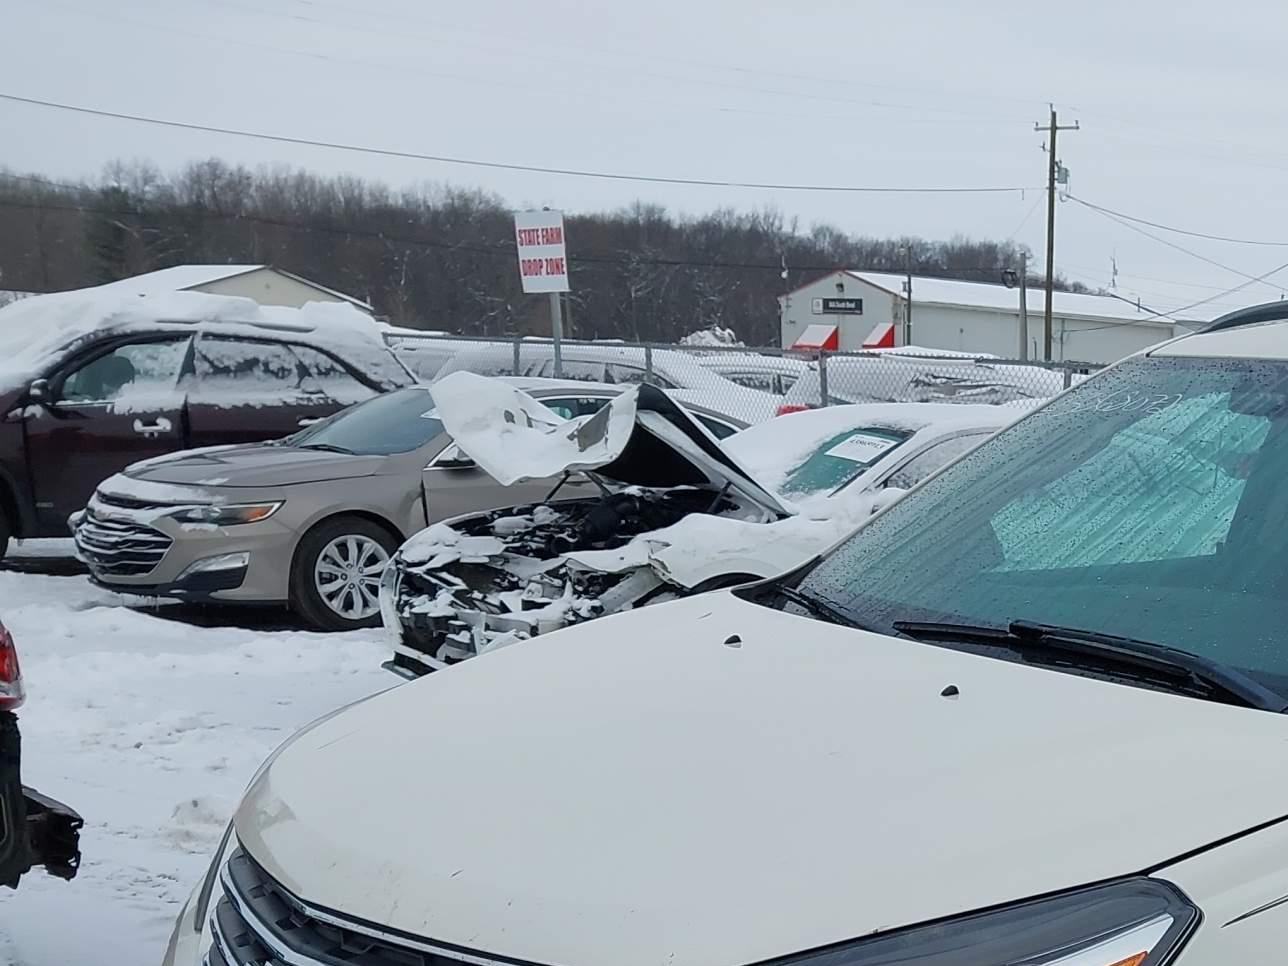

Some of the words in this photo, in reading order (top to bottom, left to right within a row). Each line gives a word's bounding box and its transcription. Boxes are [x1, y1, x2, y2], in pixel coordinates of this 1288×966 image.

[518, 228, 540, 247] STATE
[541, 227, 563, 246] FARM
[521, 258, 544, 276] DROP
[545, 257, 566, 276] ZONE
